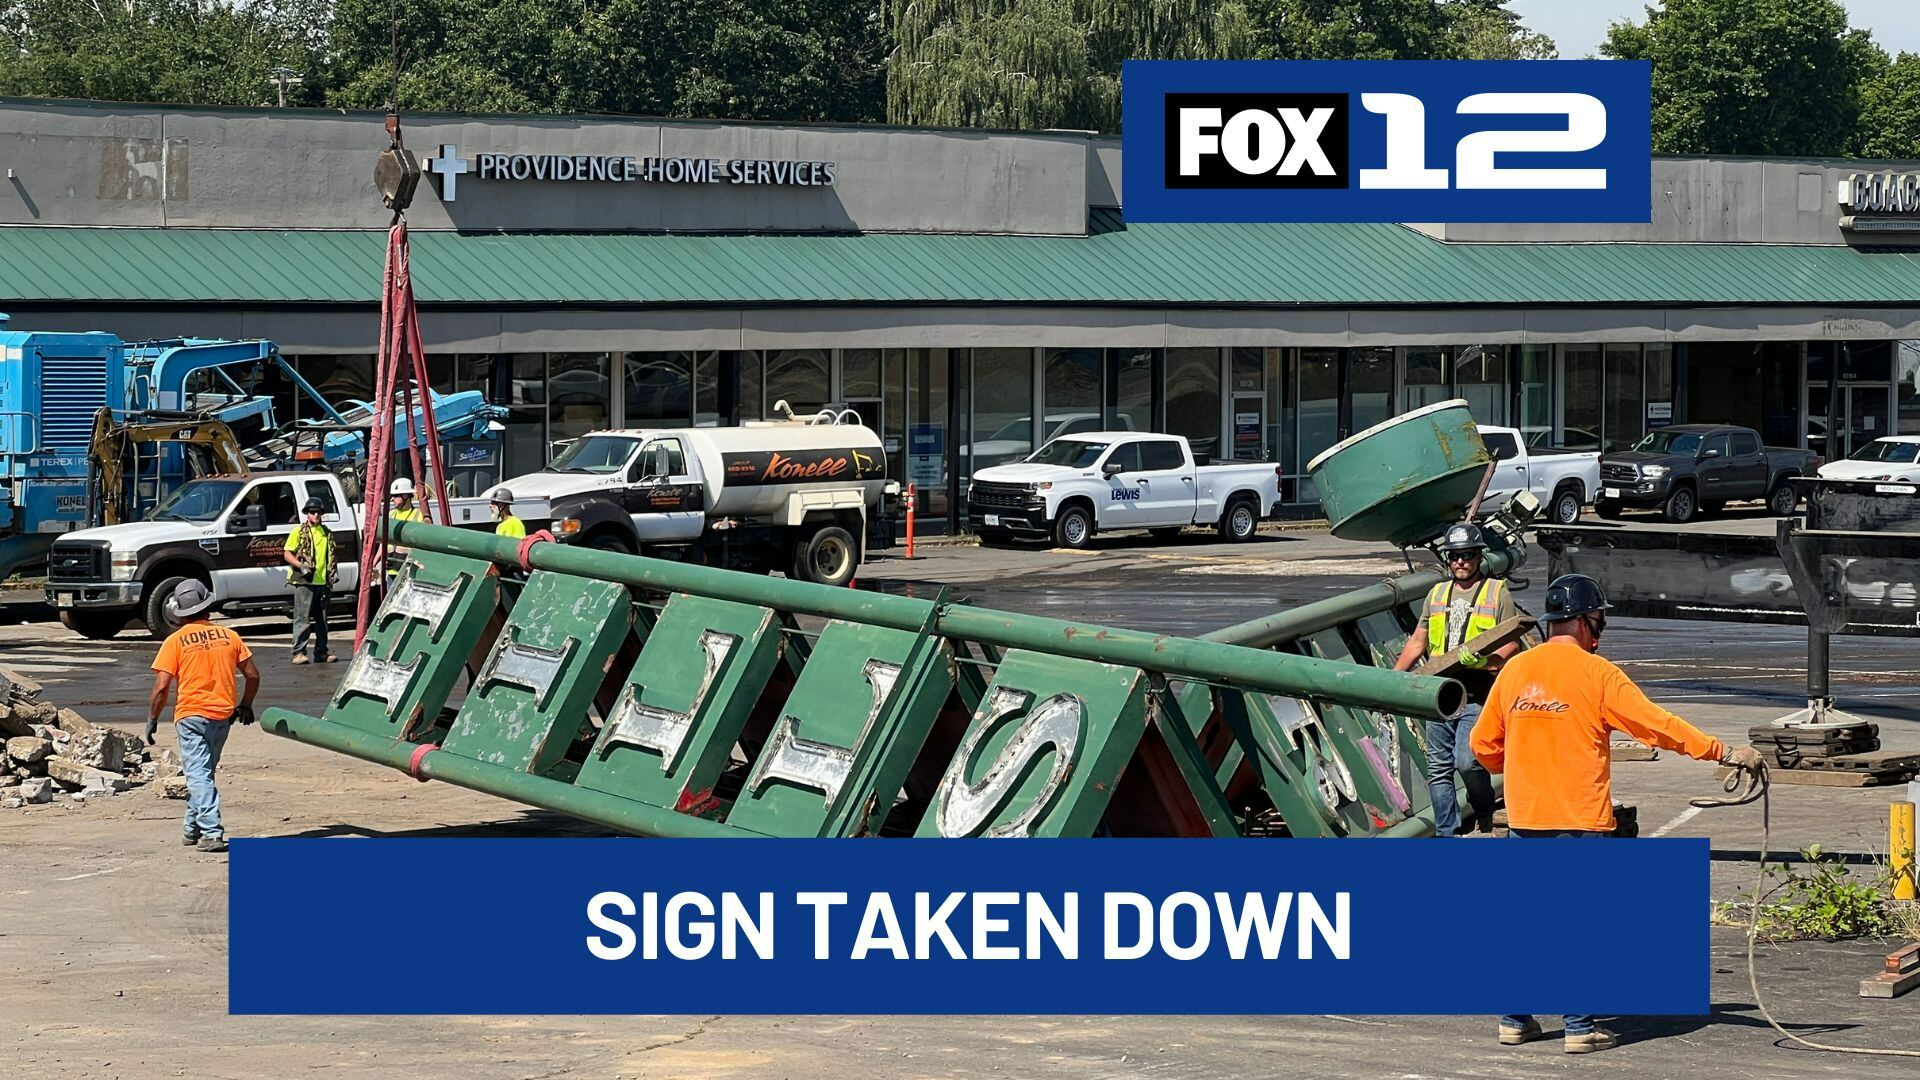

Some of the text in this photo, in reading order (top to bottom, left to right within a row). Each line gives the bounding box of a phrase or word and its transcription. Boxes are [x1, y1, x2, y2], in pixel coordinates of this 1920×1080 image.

[477, 153, 837, 187] PROVIDENCE HOME SERVICES
[179, 429, 192, 439] CAT
[41, 458, 73, 466] TEREX
[761, 452, 848, 482] Konell
[180, 627, 231, 647] KONELL
[1508, 695, 1570, 714] Konell
